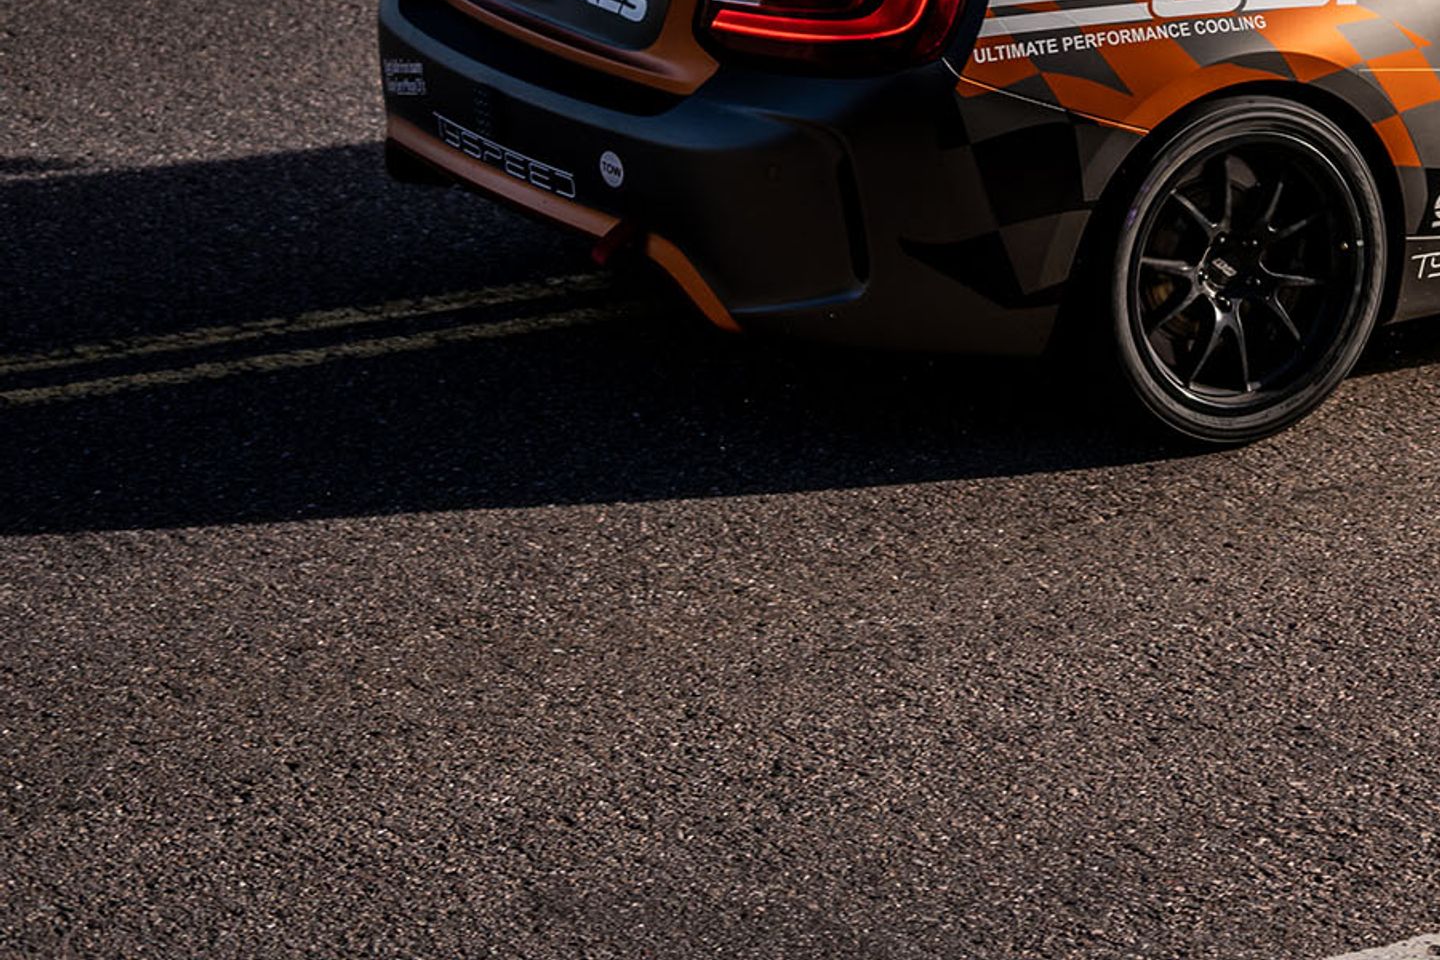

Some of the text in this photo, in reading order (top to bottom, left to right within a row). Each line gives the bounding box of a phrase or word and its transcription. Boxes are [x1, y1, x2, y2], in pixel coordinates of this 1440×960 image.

[972, 14, 1267, 64] ULTIMATE PERFORMANCE COOLING
[601, 160, 622, 179] TOW
